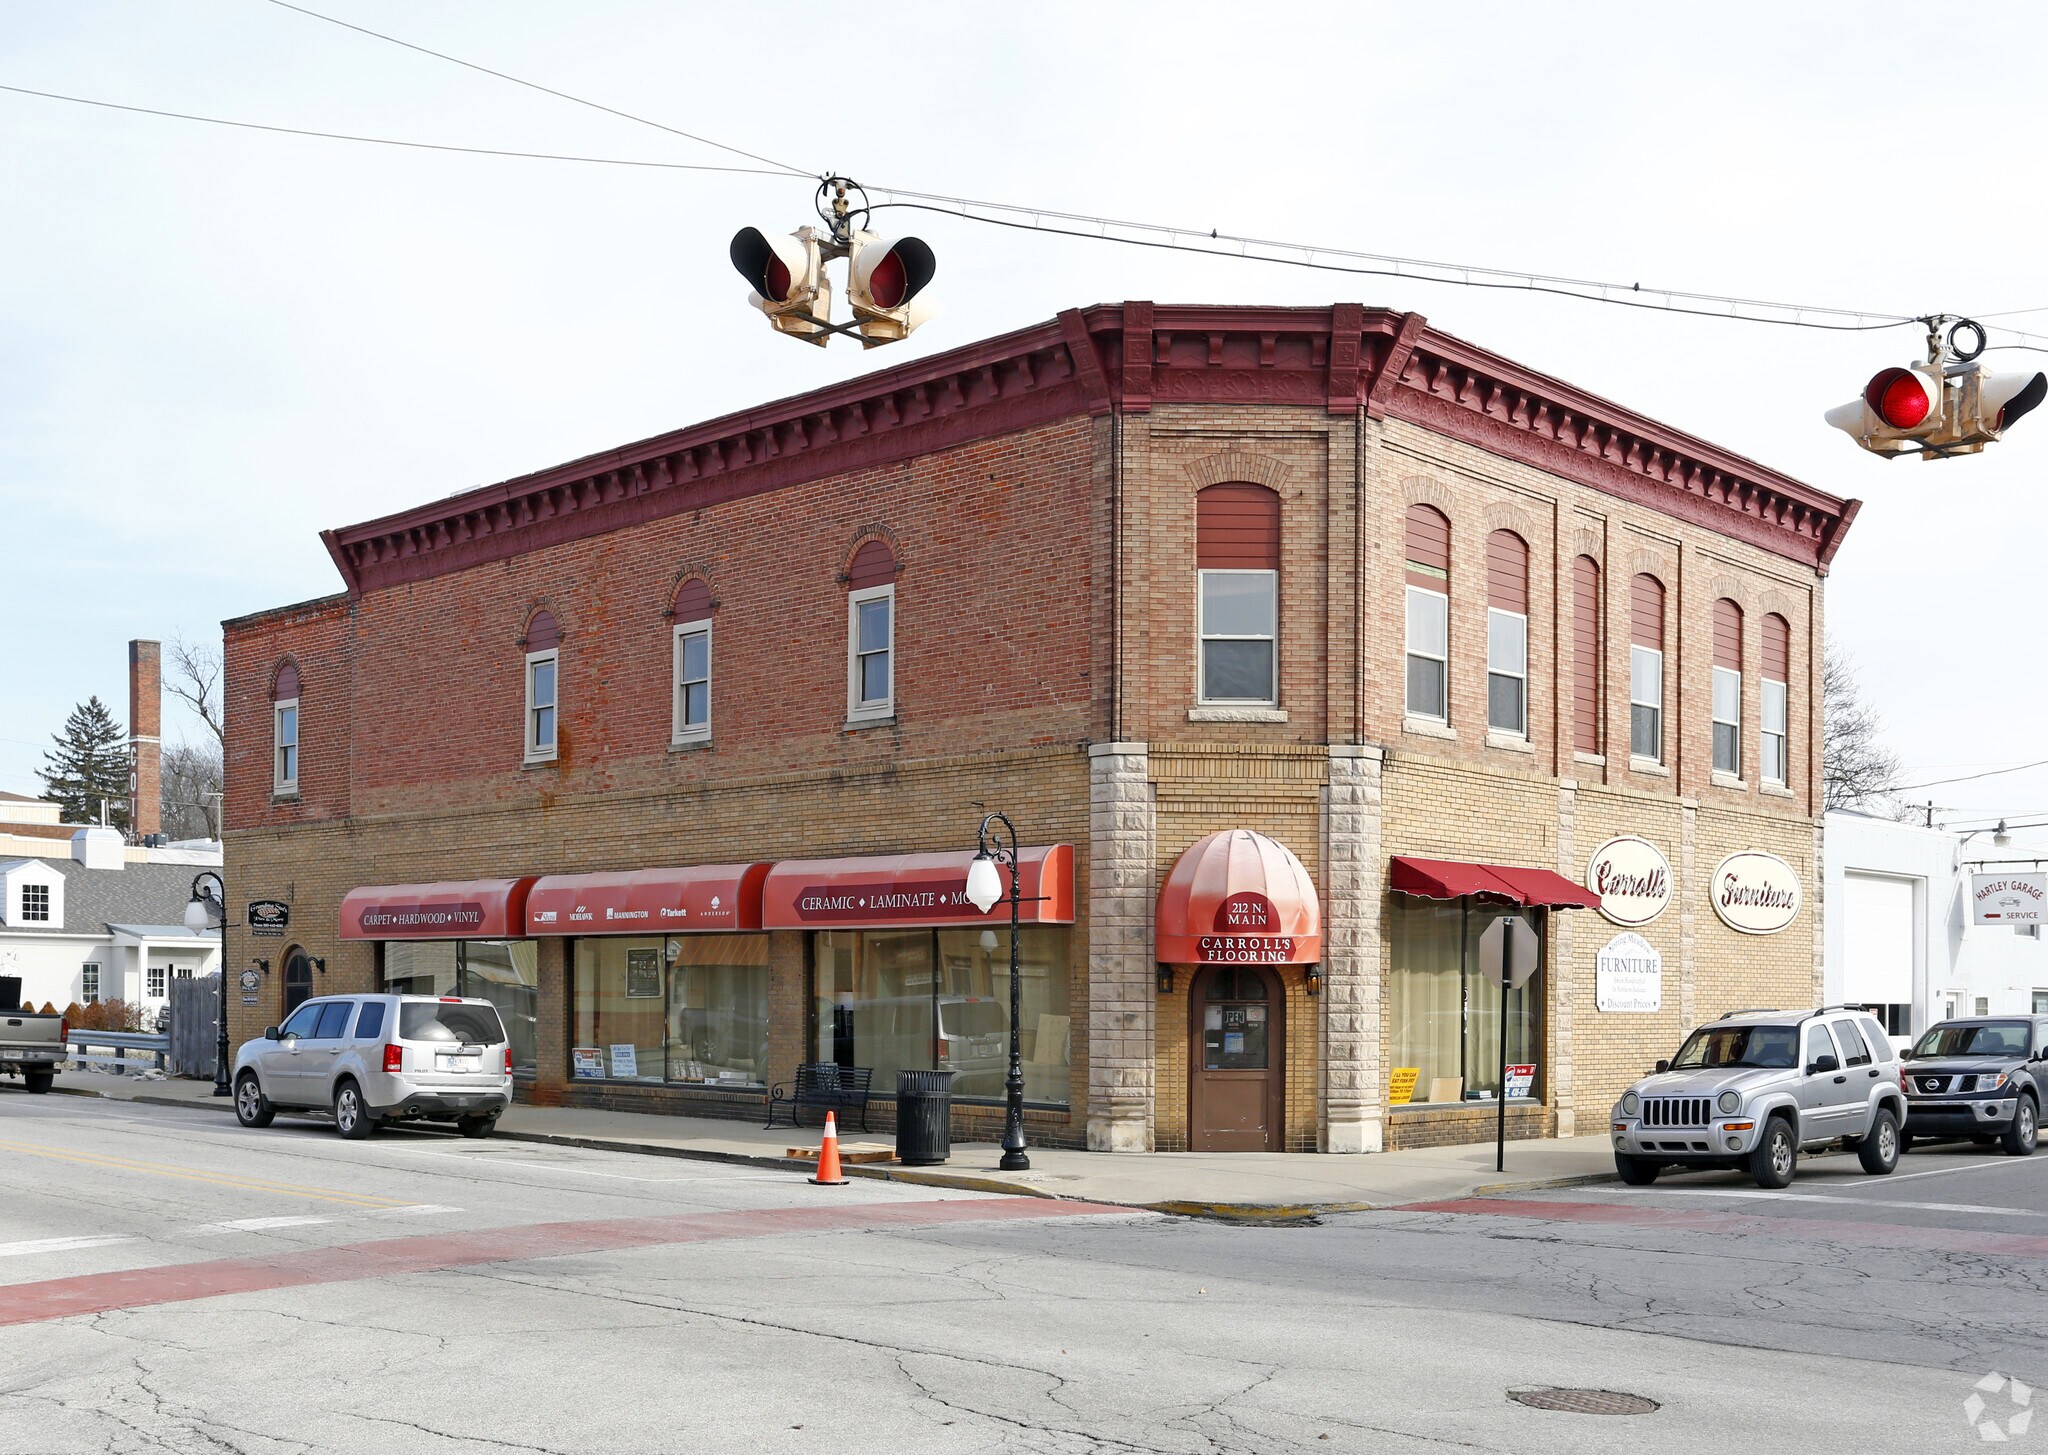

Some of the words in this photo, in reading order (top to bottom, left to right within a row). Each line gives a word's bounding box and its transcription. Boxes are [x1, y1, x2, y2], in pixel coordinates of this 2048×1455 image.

[1596, 860, 1666, 898] Carroll's
[1721, 872, 1794, 909] Furniture
[1975, 881, 2007, 901] HARTLEY
[2011, 881, 2044, 900] GARAGE
[802, 896, 855, 910] CERAMIC
[870, 892, 935, 909] LAMINATE
[666, 908, 687, 917] Tarkett
[1231, 903, 1248, 914] 212
[1252, 903, 1265, 914] N.
[363, 914, 391, 926] CARPET
[398, 912, 446, 925] HARDWOOD
[454, 911, 480, 922] VINYL
[613, 911, 649, 919] MANNINGTON
[1228, 914, 1267, 925] MAIN
[1201, 938, 1290, 950] CARROLL'S
[1207, 950, 1287, 962] FLOORING
[1601, 957, 1658, 973] FURNITURE
[1607, 999, 1633, 1009] Discount
[1633, 999, 1651, 1009] Prices
